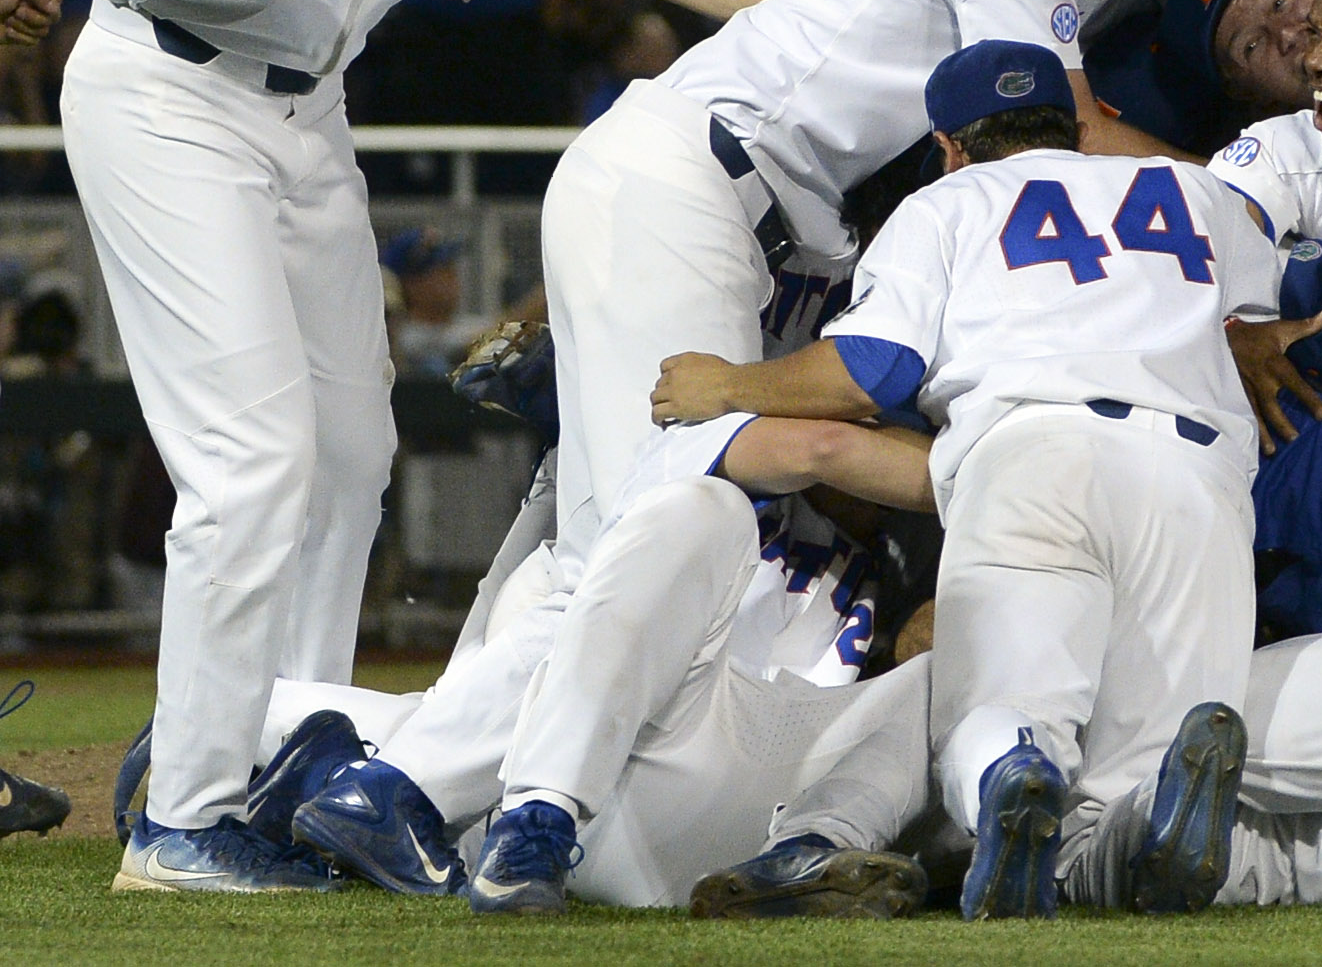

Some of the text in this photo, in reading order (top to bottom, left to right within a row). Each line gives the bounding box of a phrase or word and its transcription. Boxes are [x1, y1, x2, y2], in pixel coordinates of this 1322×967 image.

[1052, 5, 1079, 42] SEC
[1223, 137, 1260, 166] SEC
[998, 165, 1217, 285] 44
